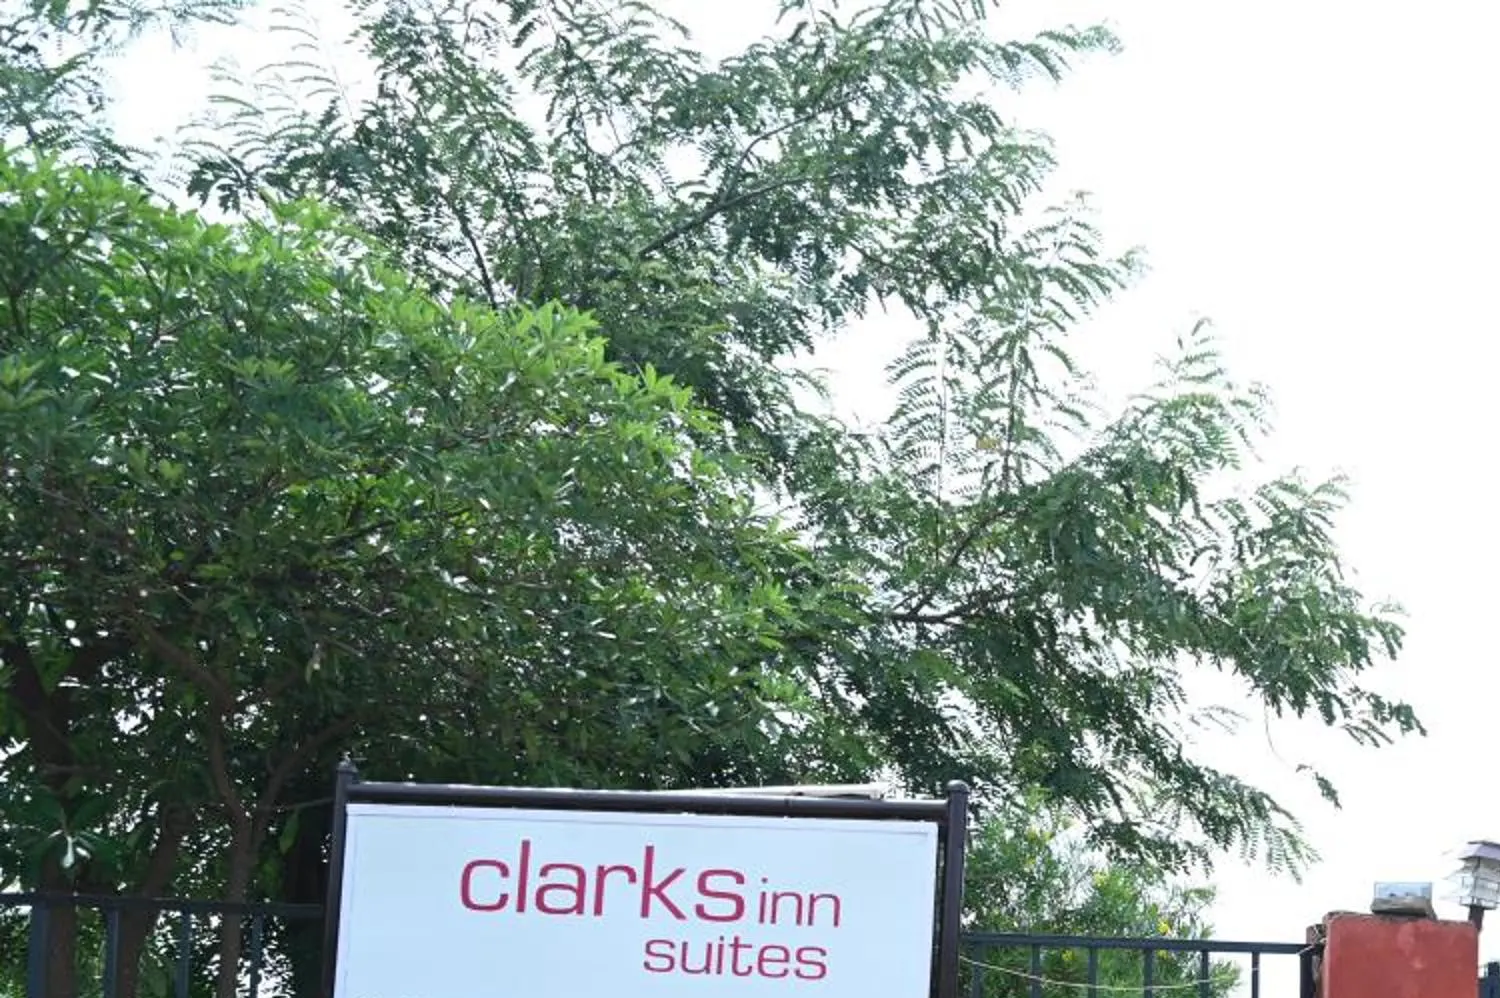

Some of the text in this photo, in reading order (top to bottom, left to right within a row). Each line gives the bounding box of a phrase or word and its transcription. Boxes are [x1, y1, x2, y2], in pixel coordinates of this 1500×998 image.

[460, 839, 841, 928] clarks inn
[643, 935, 827, 980] suites
